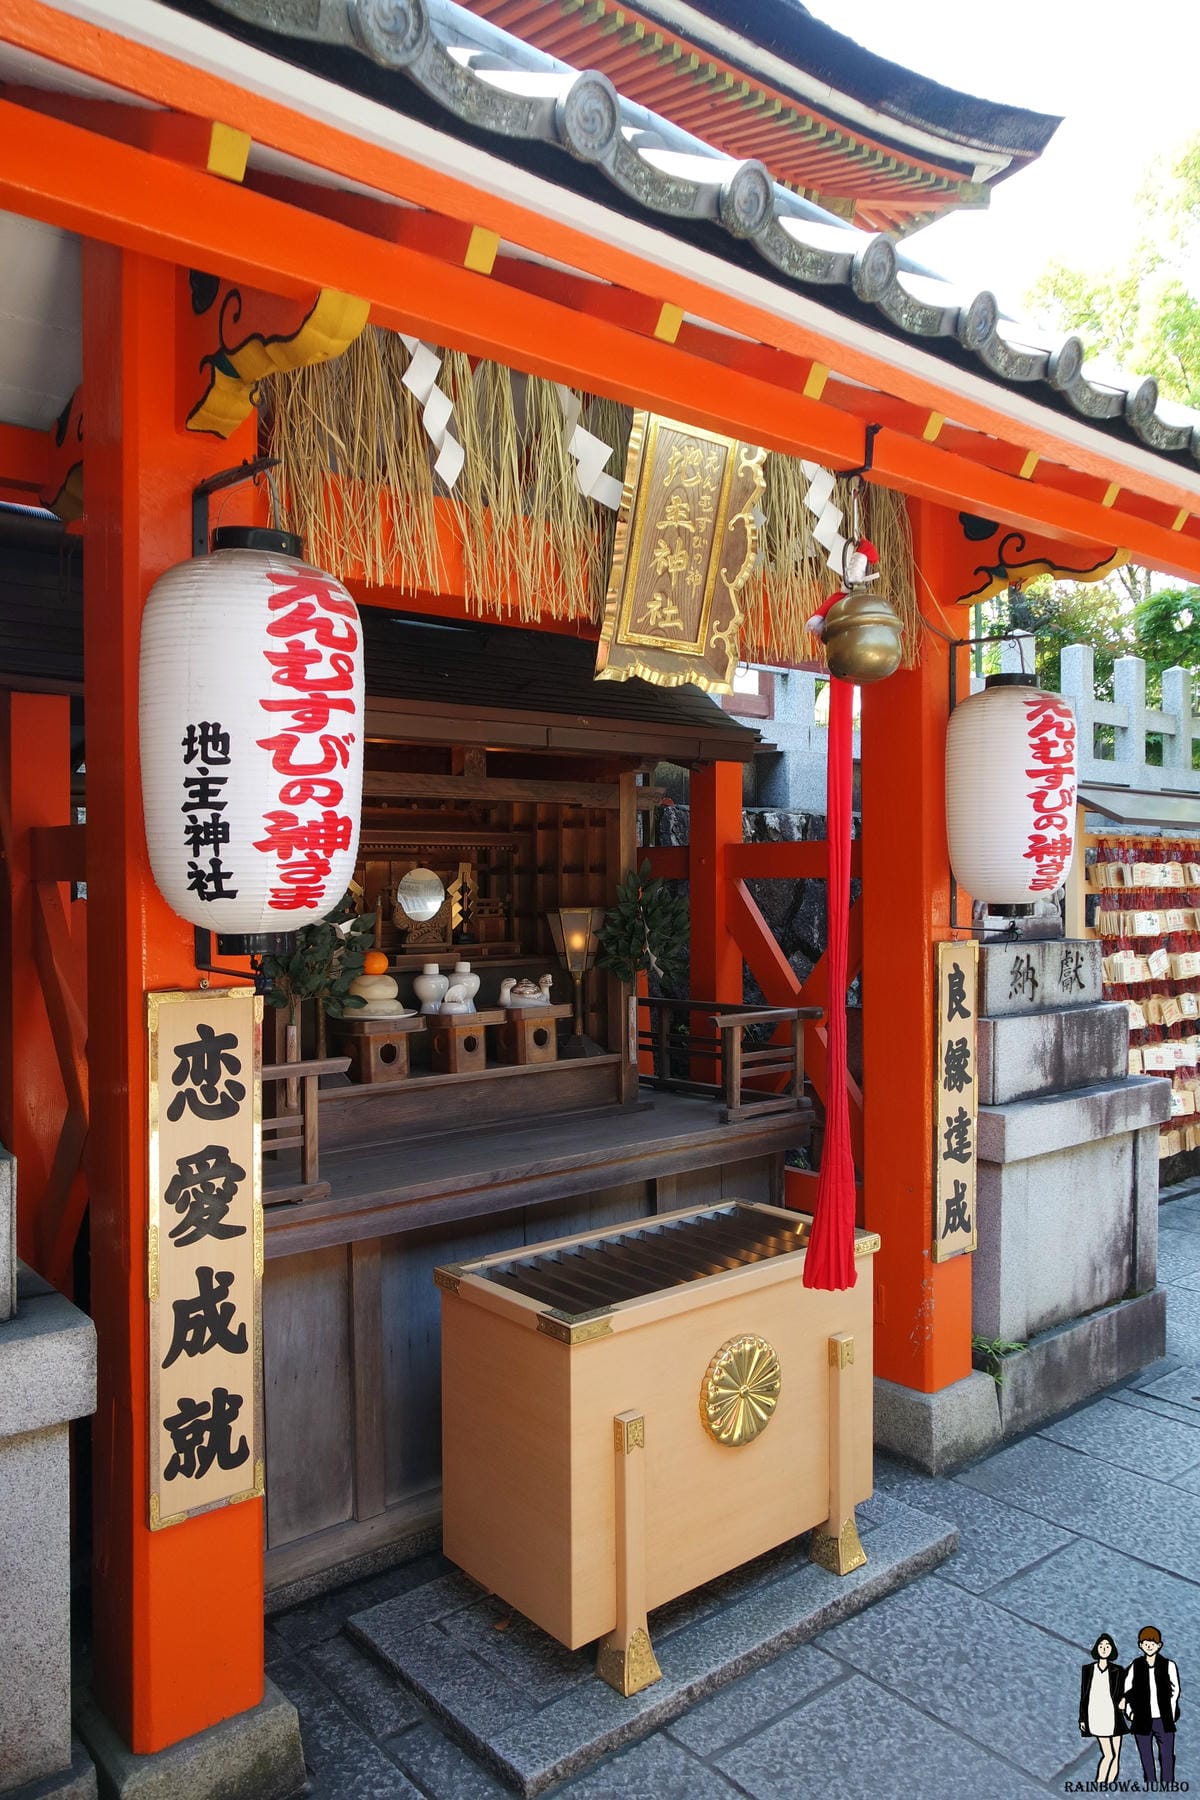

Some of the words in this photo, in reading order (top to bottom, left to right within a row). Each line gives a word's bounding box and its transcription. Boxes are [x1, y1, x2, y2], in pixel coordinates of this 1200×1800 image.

[637, 445, 704, 631] 地主神社
[181, 721, 239, 902] 地主神社
[253, 565, 359, 911] えんむすびの神さま
[161, 1024, 250, 1482] 恋愛成就
